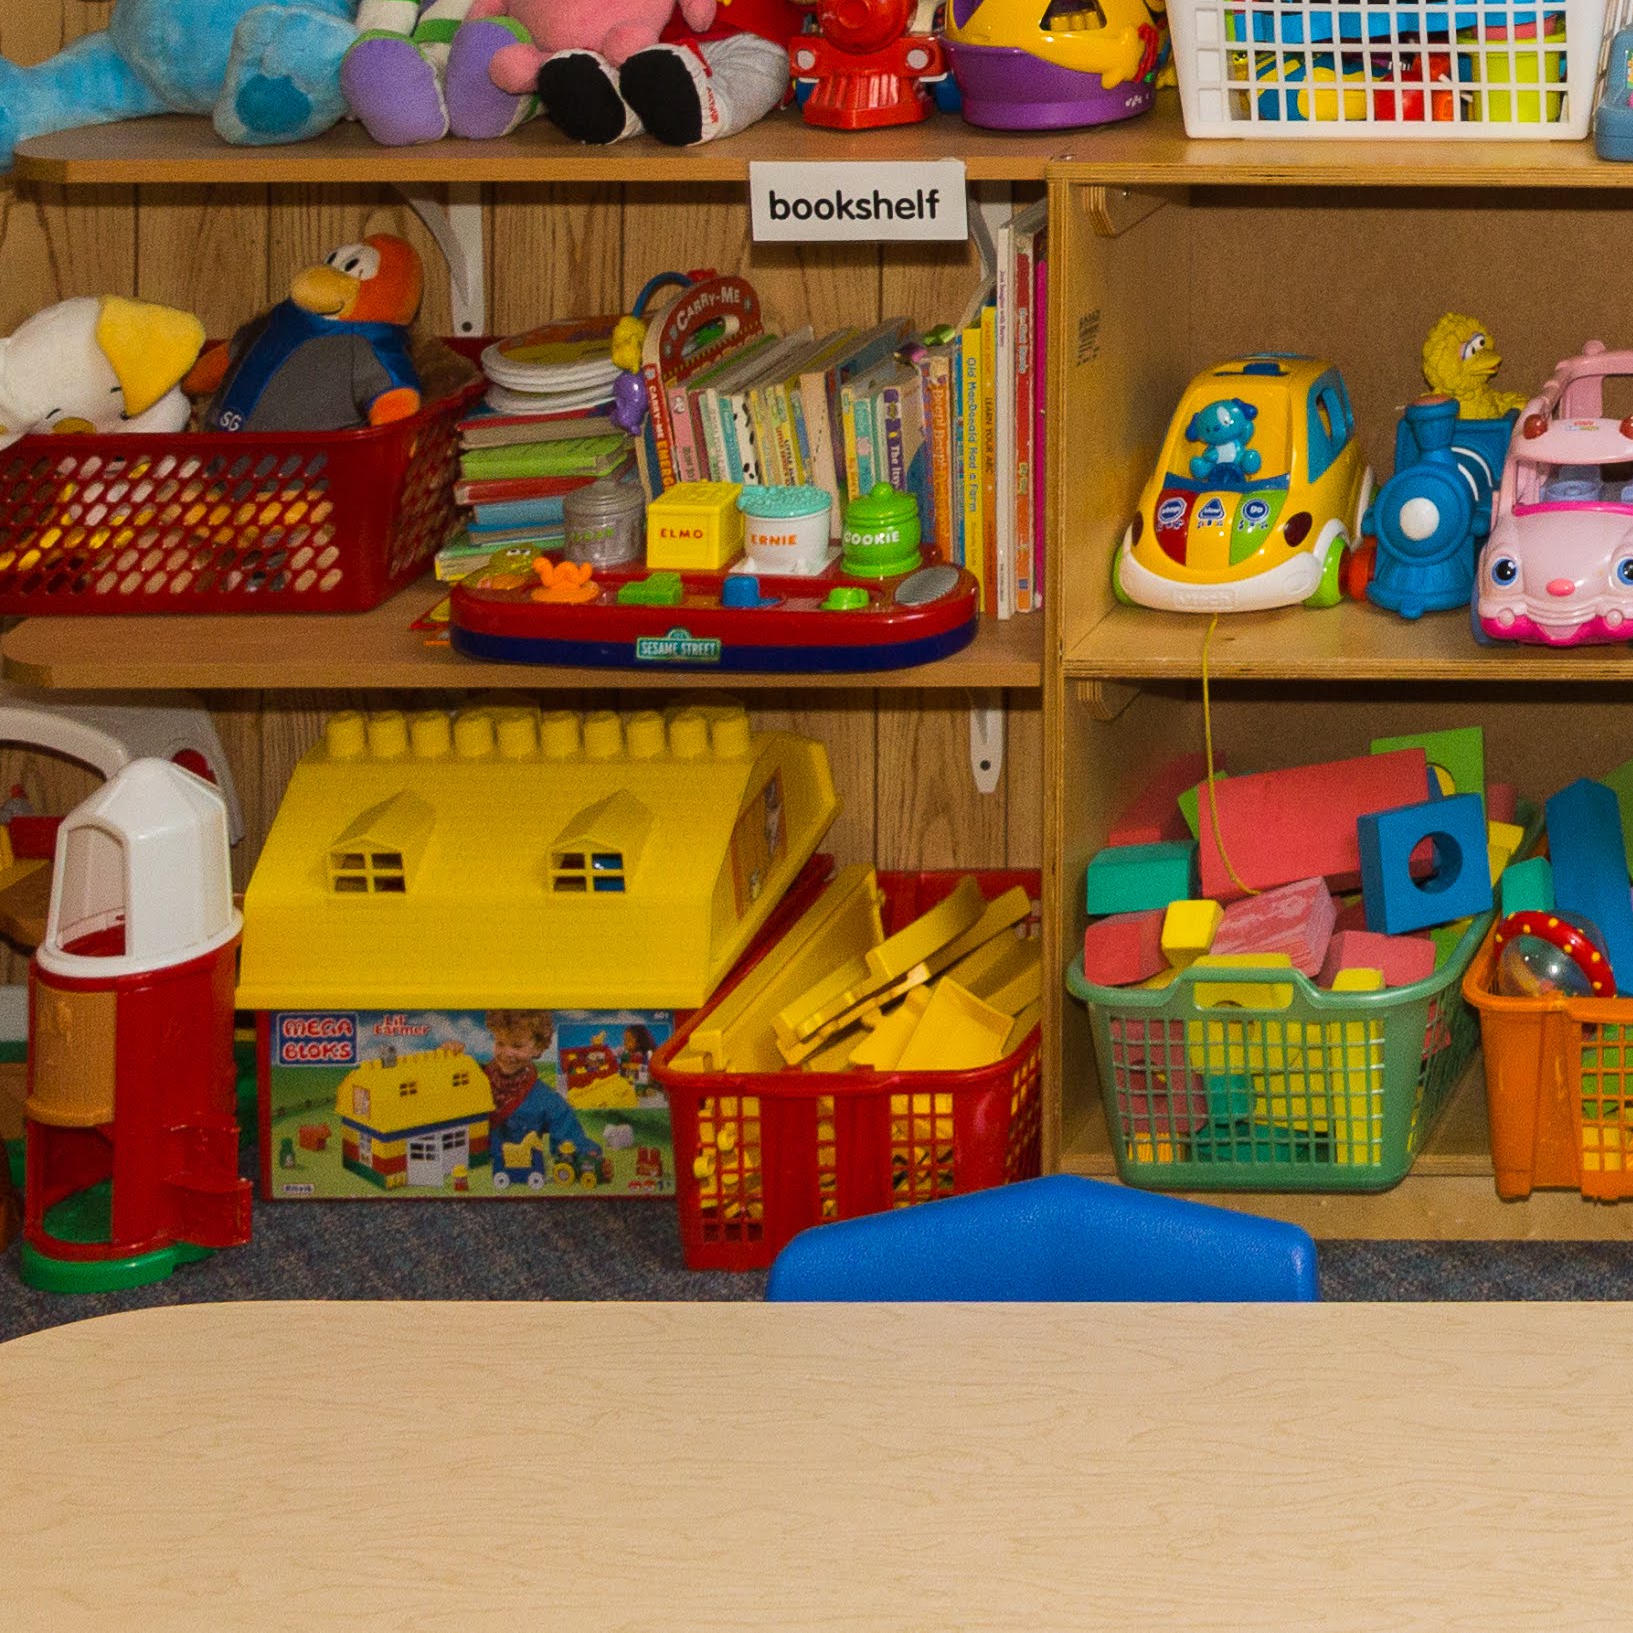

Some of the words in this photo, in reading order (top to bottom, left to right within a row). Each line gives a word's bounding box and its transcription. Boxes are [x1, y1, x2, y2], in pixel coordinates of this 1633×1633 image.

[769, 188, 941, 222] bookshelf
[677, 287, 740, 331] CARRY-ME
[967, 357, 977, 377] Old
[966, 381, 977, 442] MacDonald
[985, 397, 993, 425] LEARN
[967, 447, 977, 468] Had
[968, 484, 978, 512] Farm
[660, 528, 704, 540] ELMO
[750, 533, 798, 546] ERNIE
[844, 530, 900, 546] COOKIE
[640, 642, 679, 655] SESAME
[680, 642, 717, 655] STREET
[282, 1016, 353, 1037] MEGA
[373, 1024, 432, 1037] Farmer
[282, 1040, 352, 1061] BLOKS
